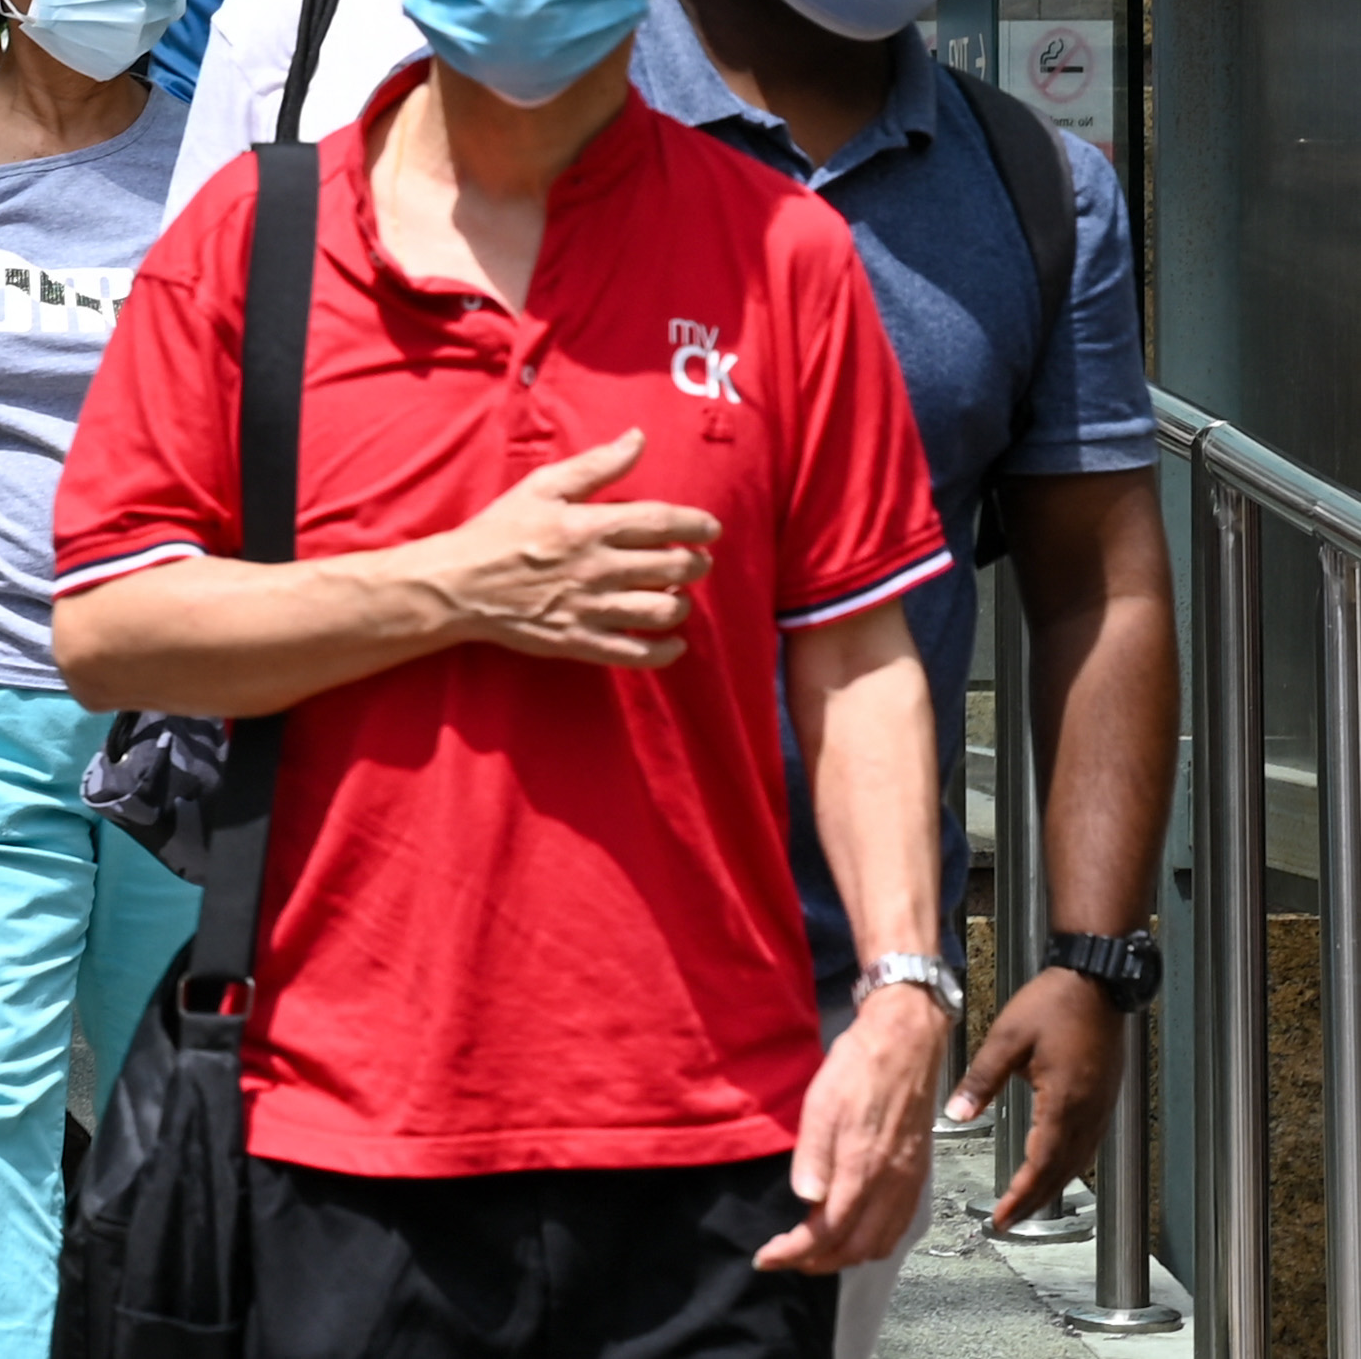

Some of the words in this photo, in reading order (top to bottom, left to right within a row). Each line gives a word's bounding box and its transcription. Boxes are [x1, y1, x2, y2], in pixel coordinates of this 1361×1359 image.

[948, 36, 970, 73] EXIT
[668, 317, 720, 351] my
[670, 344, 742, 405] CK
